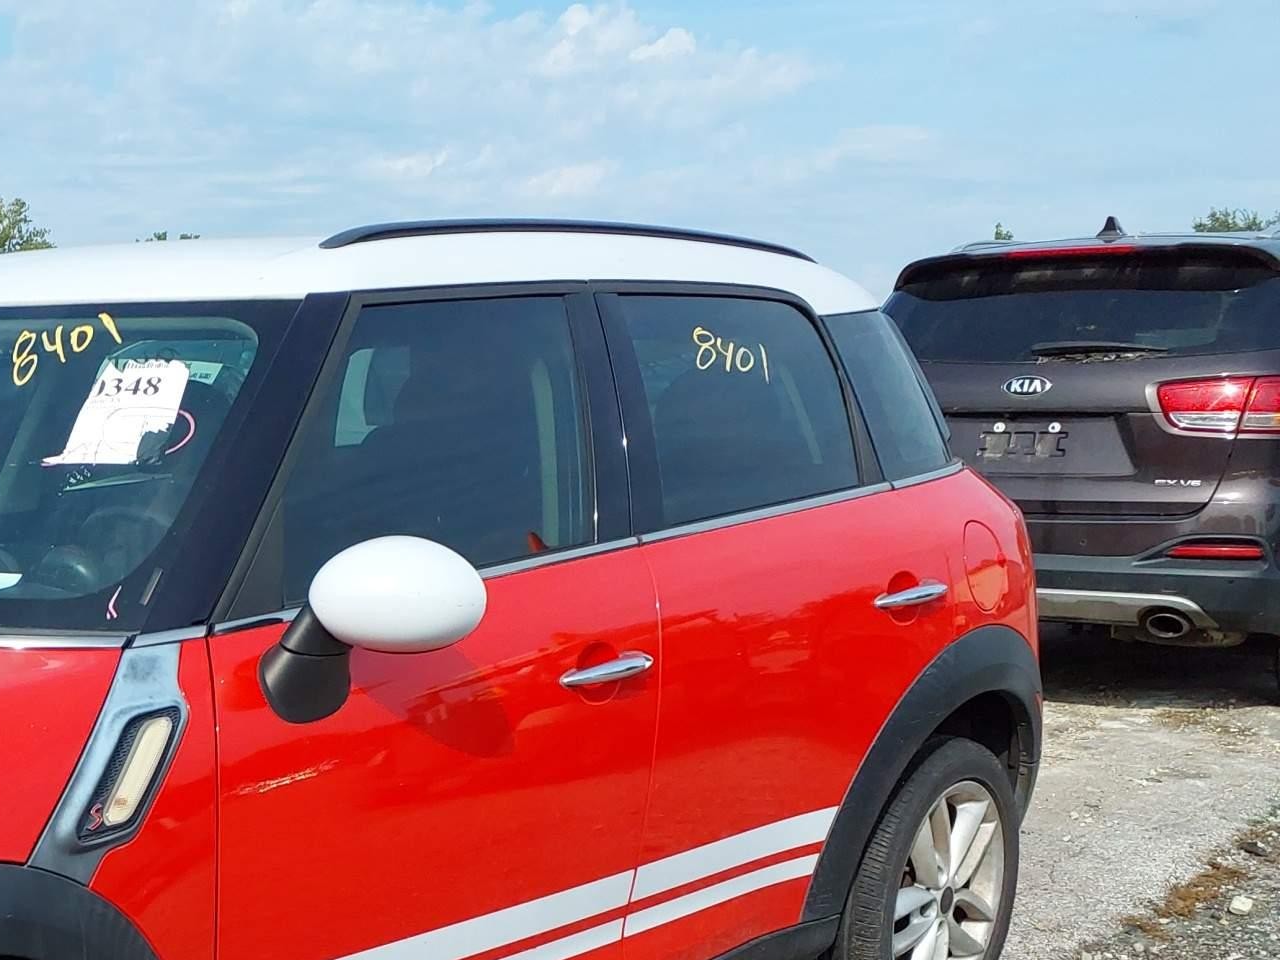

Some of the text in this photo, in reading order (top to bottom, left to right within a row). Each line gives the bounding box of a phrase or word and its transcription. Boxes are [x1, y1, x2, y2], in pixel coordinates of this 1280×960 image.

[12, 312, 122, 386] 8401
[693, 326, 770, 385] 8401
[1010, 379, 1042, 393] KIA
[1180, 479, 1202, 488] V6
